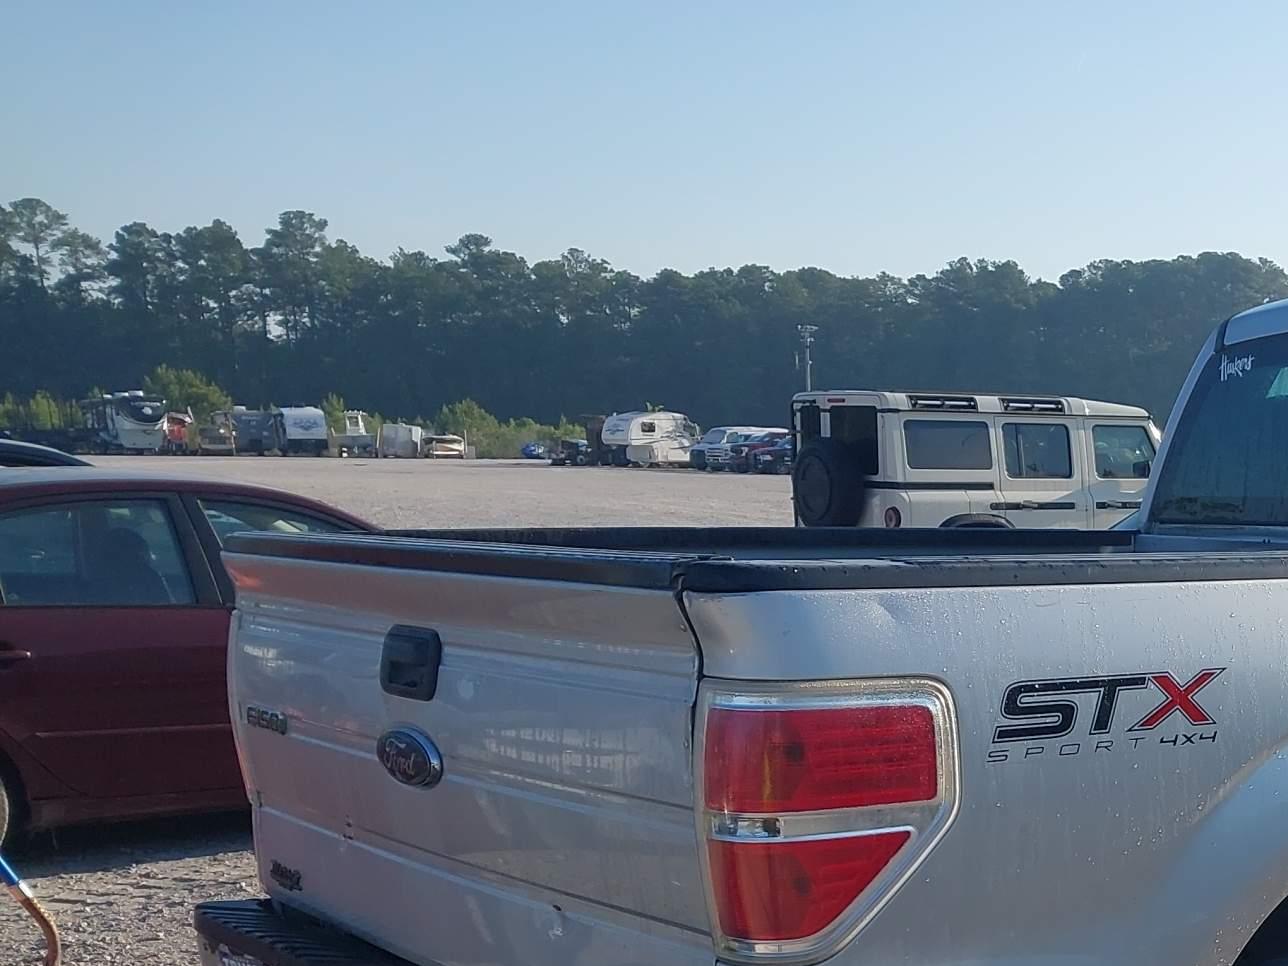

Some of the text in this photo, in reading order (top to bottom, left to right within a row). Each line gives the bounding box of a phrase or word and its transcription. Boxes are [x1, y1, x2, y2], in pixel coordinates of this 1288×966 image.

[992, 667, 1227, 744] STX
[383, 739, 415, 776] Ford
[986, 736, 1146, 763] SPORT
